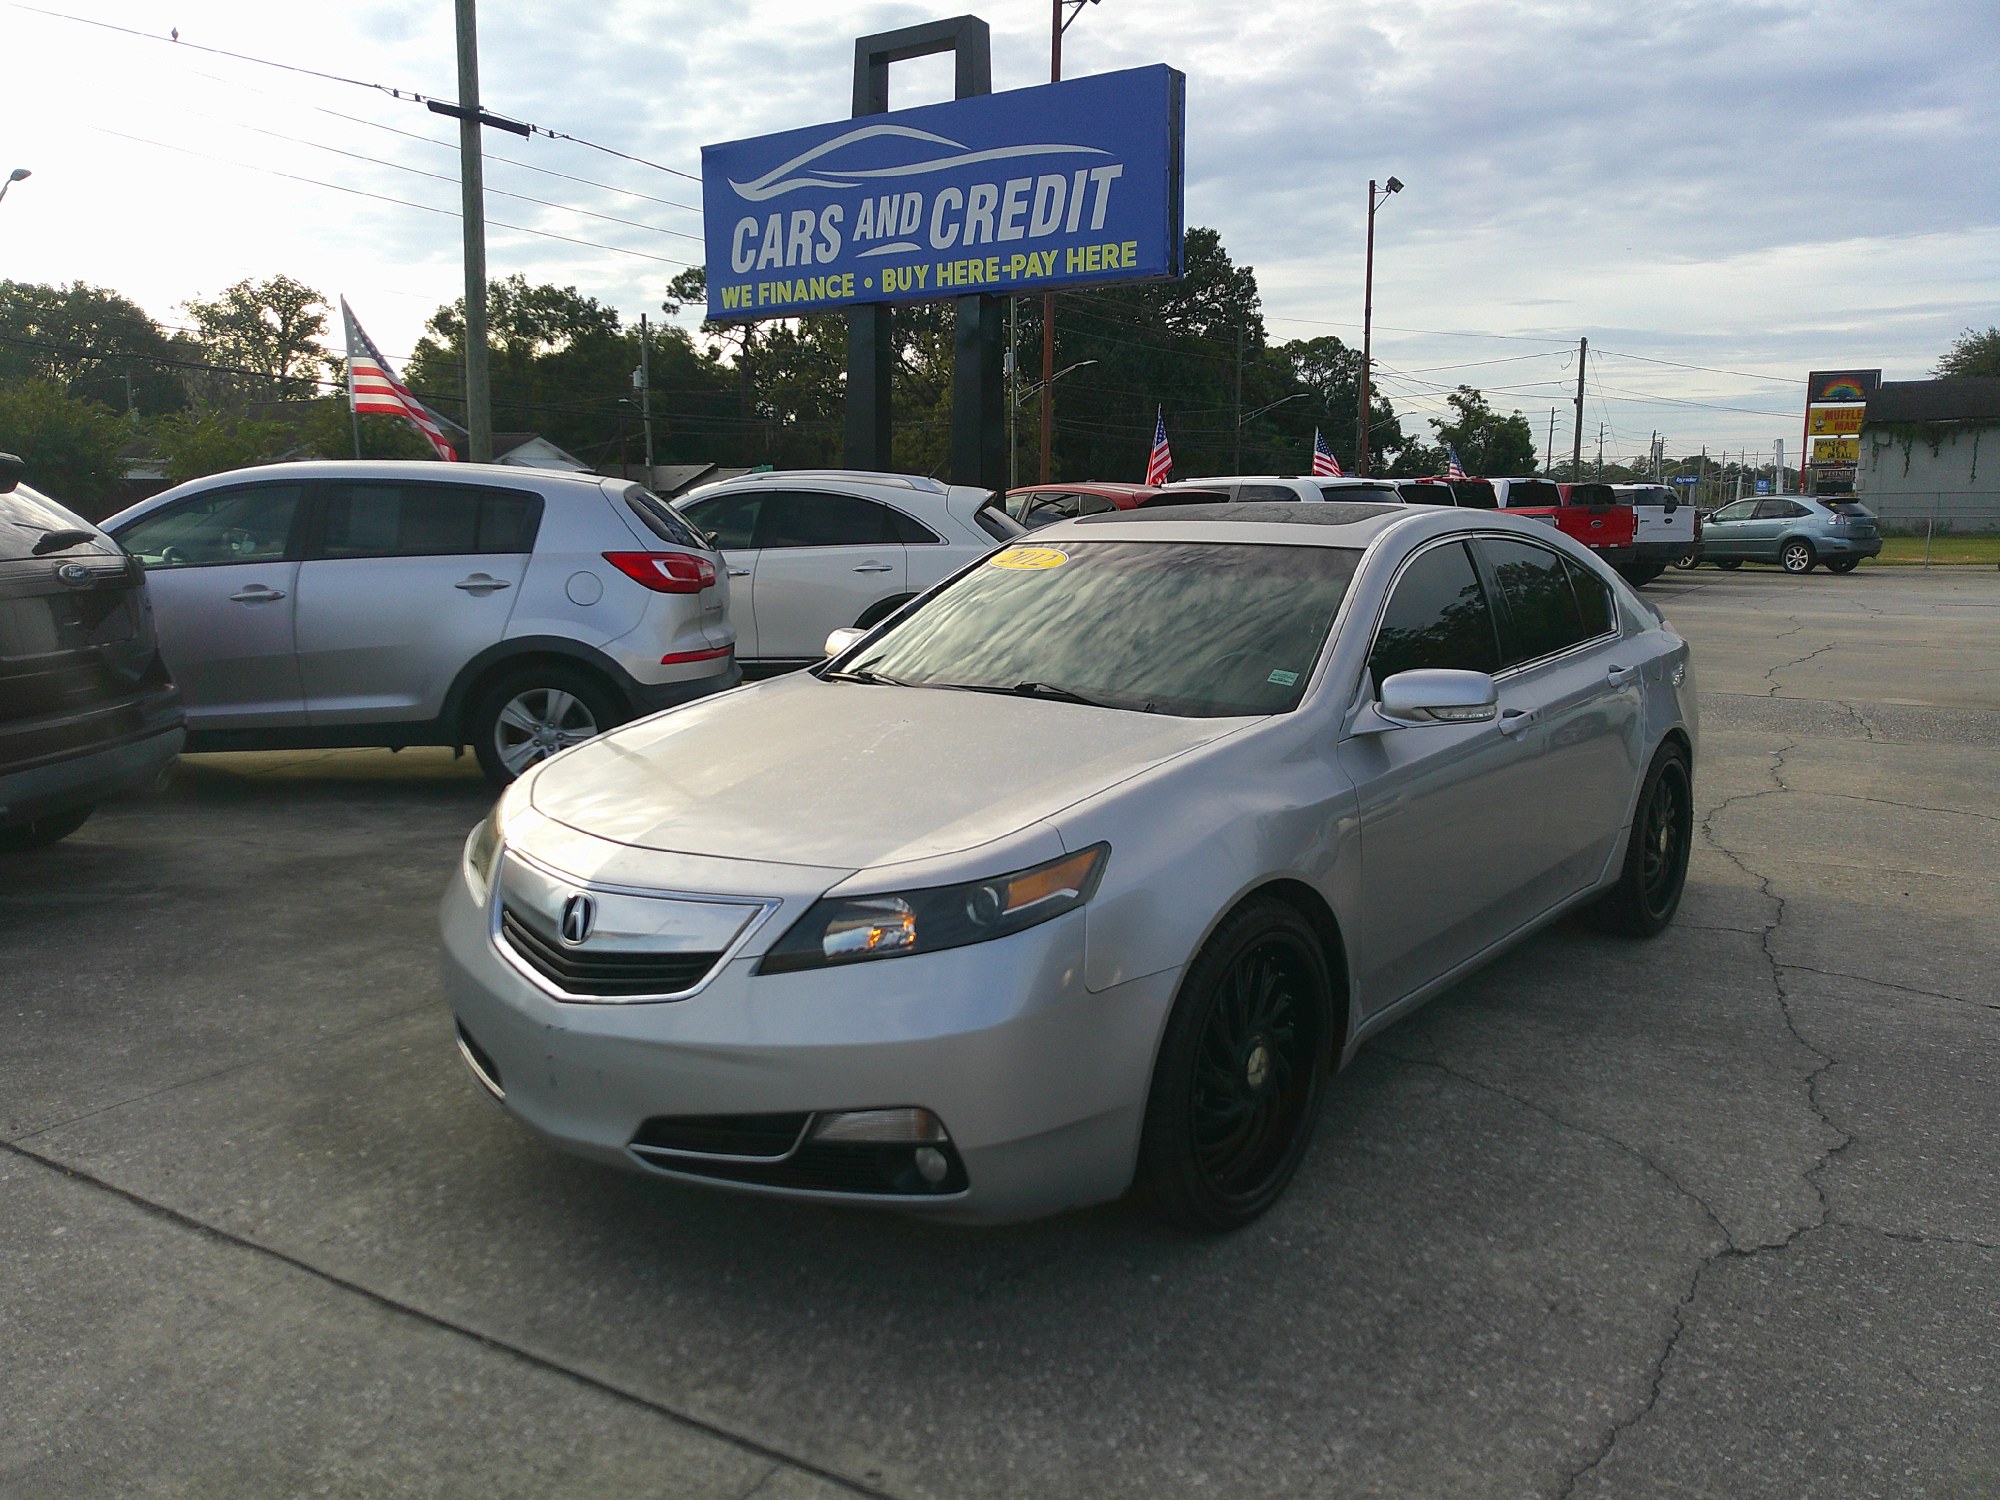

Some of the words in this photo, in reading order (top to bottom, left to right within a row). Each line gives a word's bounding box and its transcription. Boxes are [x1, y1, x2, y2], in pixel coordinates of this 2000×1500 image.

[731, 204, 844, 274] CARS
[852, 192, 923, 242] AND
[929, 163, 1124, 250] CREDIT
[721, 285, 752, 309] WE
[758, 273, 855, 305] FINANCE
[882, 264, 930, 293] BUY
[1066, 240, 1138, 273] HERE
